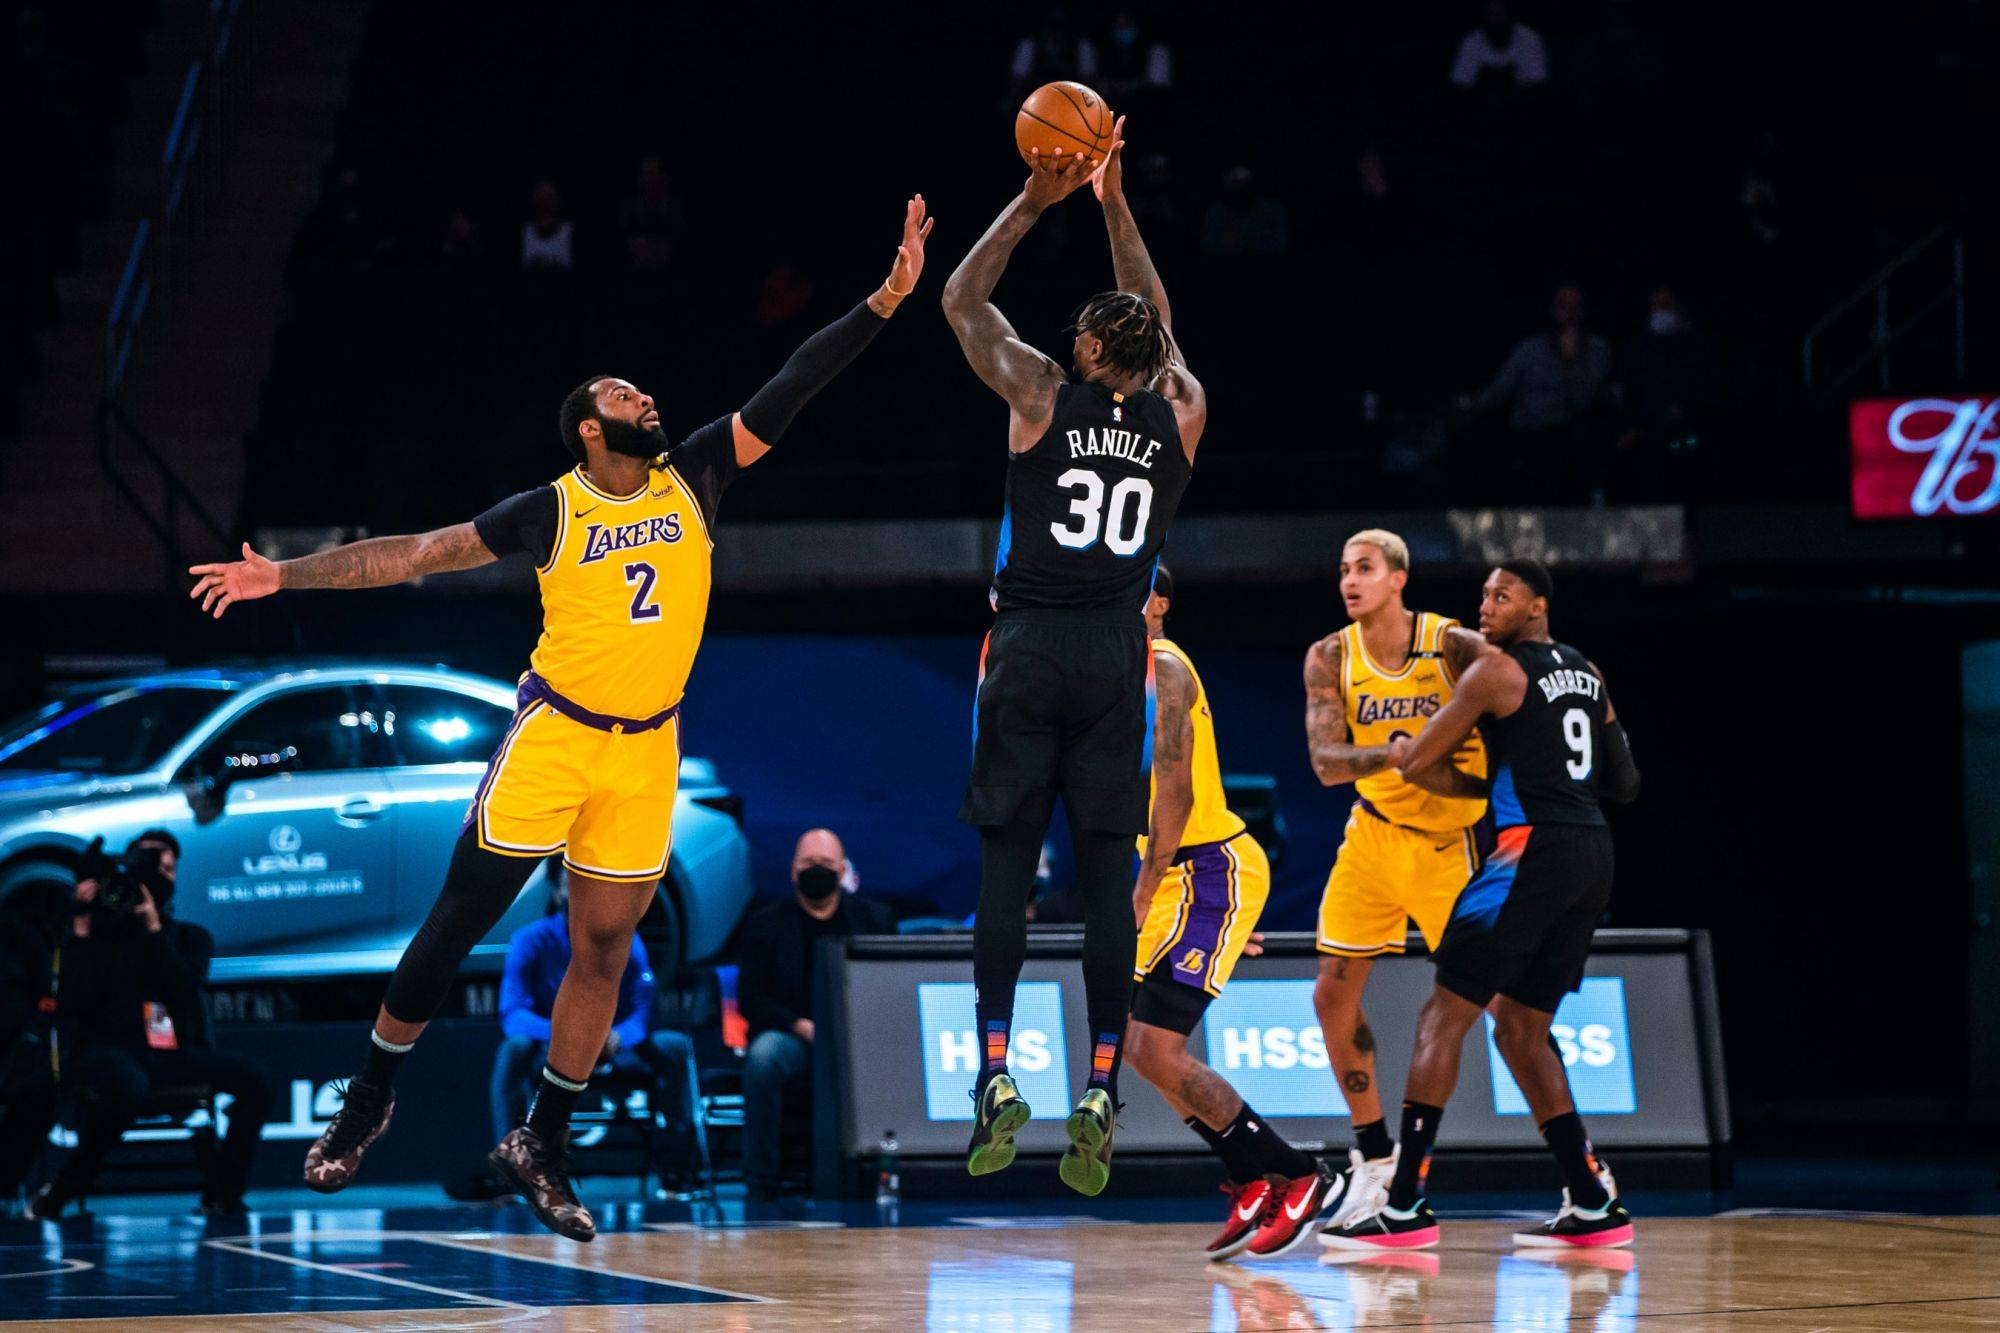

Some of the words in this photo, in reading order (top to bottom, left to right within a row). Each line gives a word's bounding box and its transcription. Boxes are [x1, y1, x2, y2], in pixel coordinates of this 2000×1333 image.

[1066, 427, 1162, 469] RANDLE
[1050, 468, 1154, 557] 30
[578, 513, 683, 565] LAKERS
[624, 561, 662, 624] 2
[1537, 669, 1601, 703] BARRETT
[1356, 692, 1441, 725] LAKERS
[1562, 708, 1592, 780] 9
[243, 852, 327, 875] LEXUS
[940, 1029, 1052, 1072] HS
[1223, 1026, 1330, 1069] HSS
